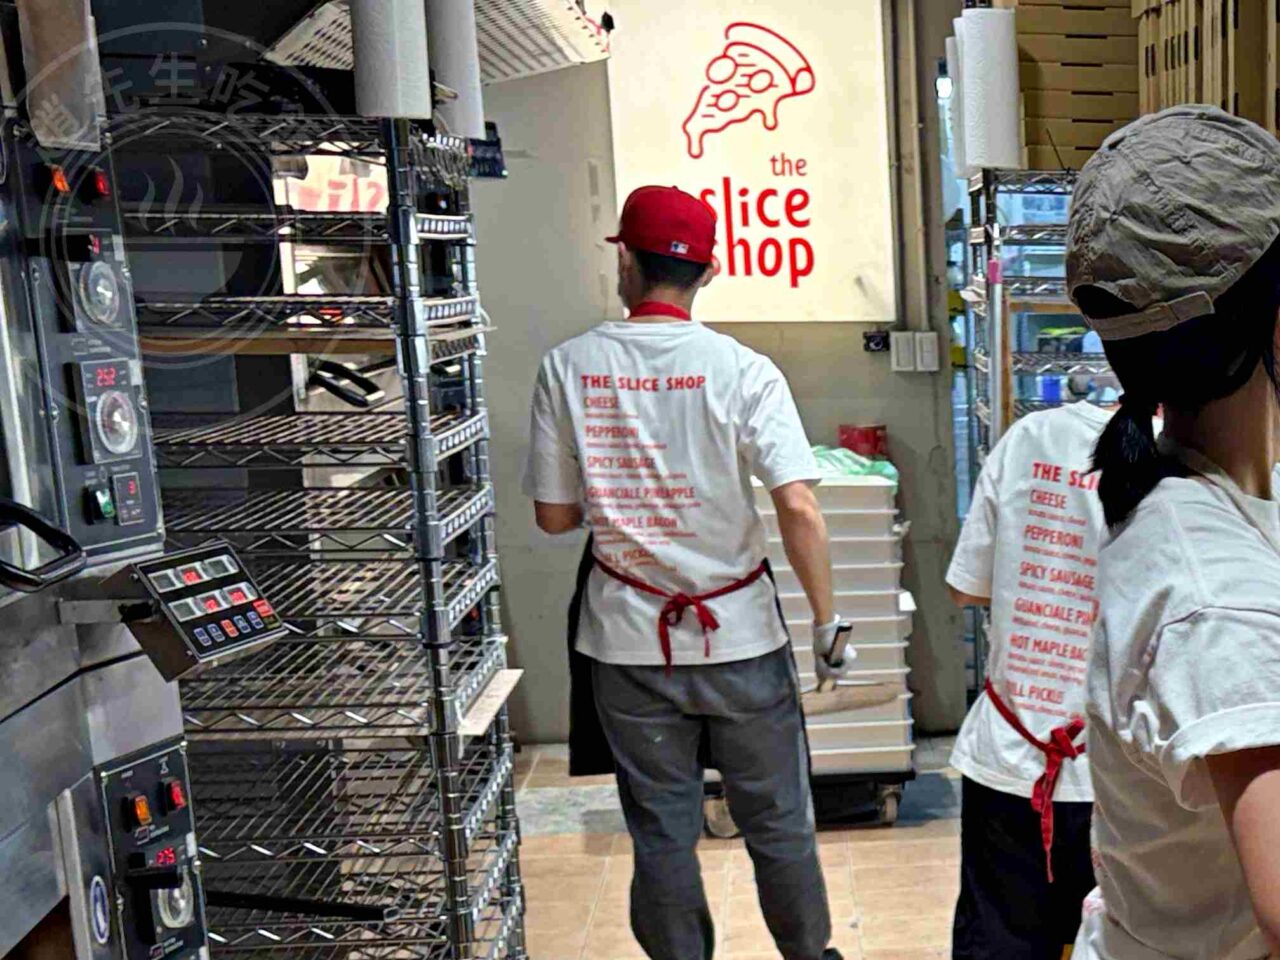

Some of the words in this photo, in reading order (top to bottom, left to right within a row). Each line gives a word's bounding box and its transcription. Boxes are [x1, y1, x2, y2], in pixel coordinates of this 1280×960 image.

[770, 152, 808, 177] the
[581, 375, 611, 389] THE
[618, 376, 659, 391] SLICE
[666, 375, 706, 391] SHOP
[584, 396, 619, 408] CHEESE
[1032, 462, 1062, 483] THE
[1030, 489, 1067, 510] CHEESE
[1024, 524, 1084, 550] PEPPERONI
[1019, 561, 1046, 581] SPICY
[1049, 567, 1095, 590] SAUSAGE
